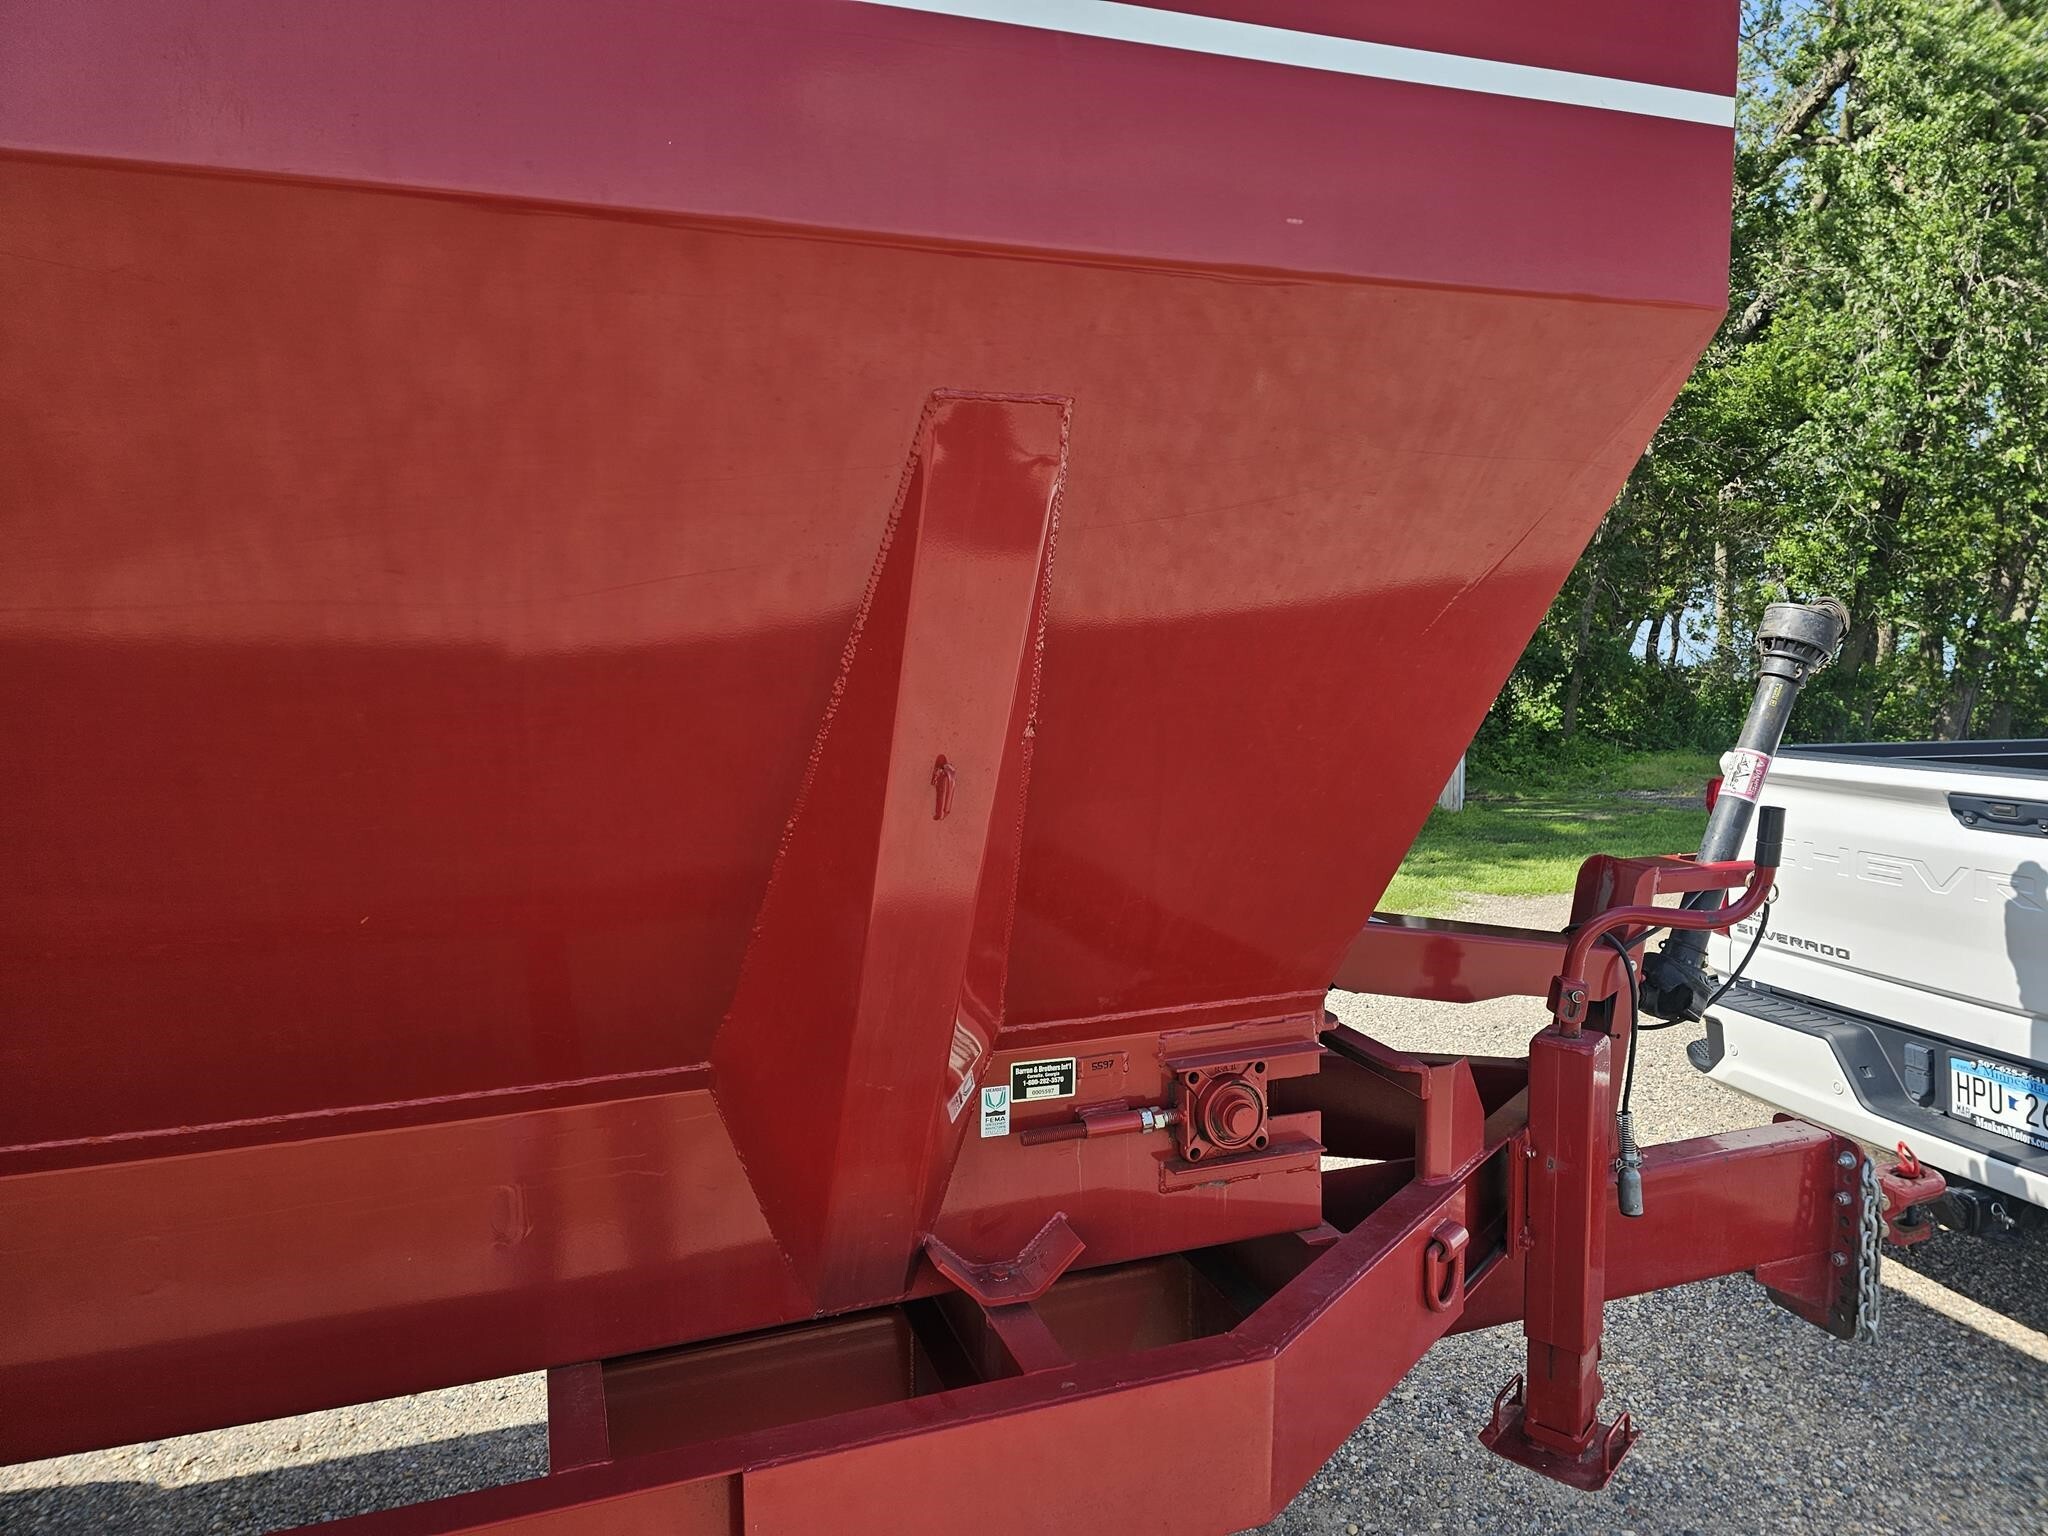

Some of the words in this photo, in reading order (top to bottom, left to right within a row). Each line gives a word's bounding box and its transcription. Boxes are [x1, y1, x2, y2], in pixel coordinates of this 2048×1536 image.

[1736, 922, 1851, 960] SILVERADO
[1091, 1060, 1114, 1071] 5597
[1957, 1071, 2003, 1115] HPU
